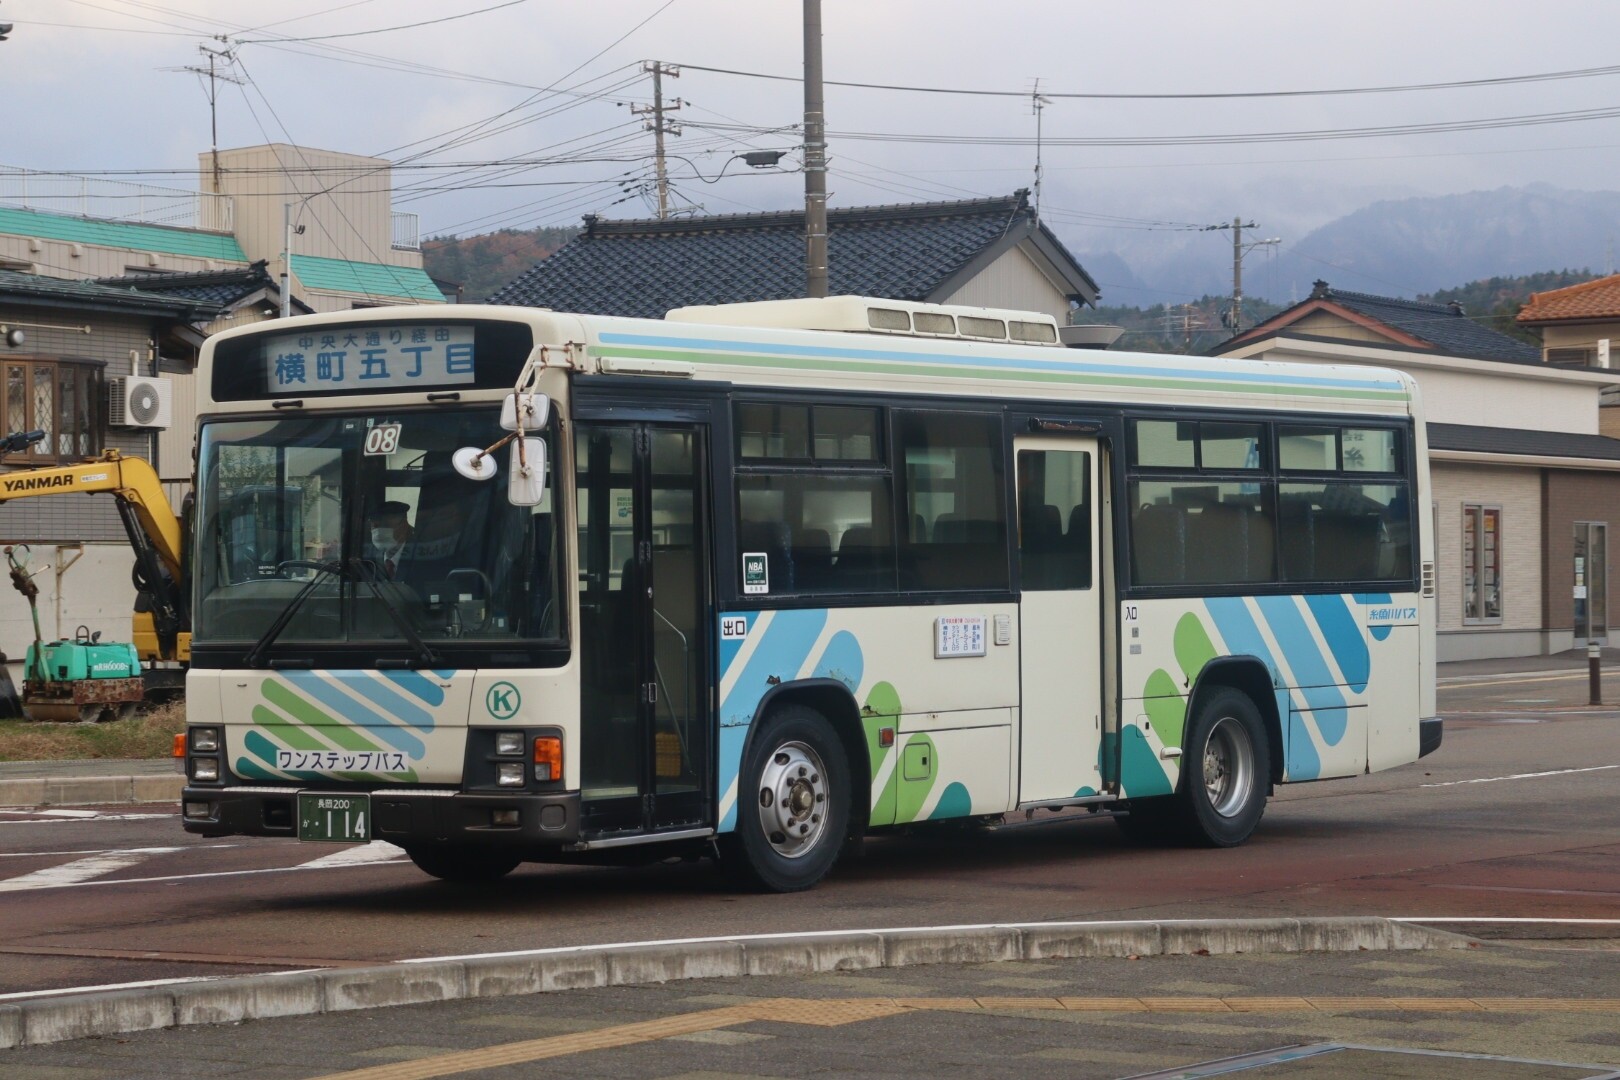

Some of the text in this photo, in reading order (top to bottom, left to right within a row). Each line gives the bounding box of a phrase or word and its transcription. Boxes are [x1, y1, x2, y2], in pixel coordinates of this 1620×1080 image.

[299, 327, 450, 350] 中央大通り経由
[275, 343, 474, 385] 横町五丁目
[367, 428, 397, 453] 08
[4, 474, 73, 492] YANMAR
[748, 562, 763, 571] NBA
[1125, 606, 1138, 621] 入口
[1369, 607, 1417, 620] 糸魚川バス
[723, 620, 745, 636] 出口
[279, 751, 407, 772] ワンステップバス
